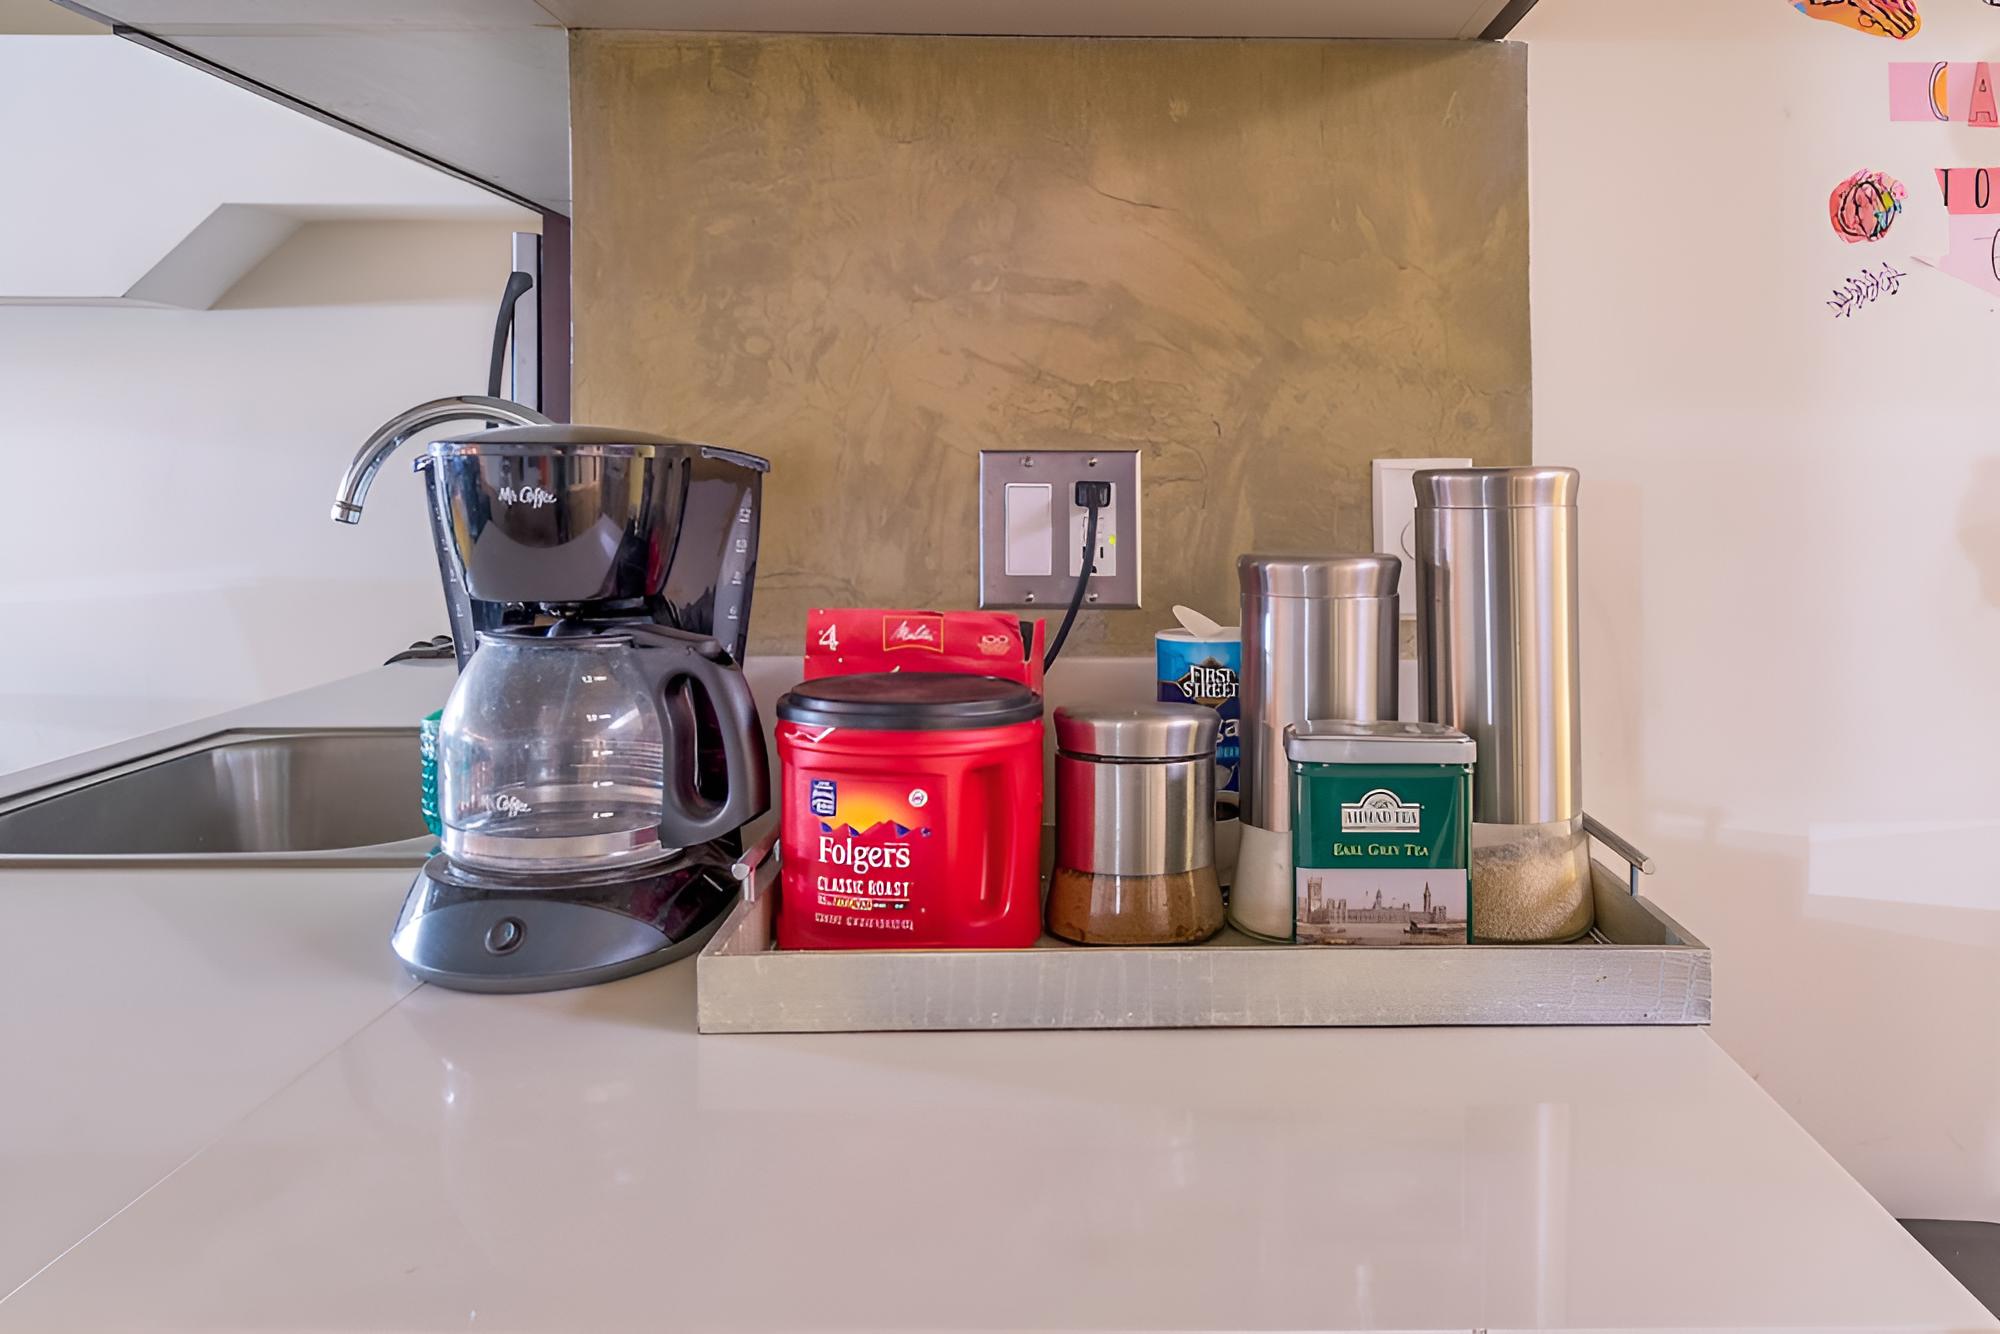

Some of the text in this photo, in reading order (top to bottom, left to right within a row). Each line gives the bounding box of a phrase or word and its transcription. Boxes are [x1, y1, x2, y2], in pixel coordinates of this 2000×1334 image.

[520, 486, 557, 508] Coffee
[819, 624, 839, 651] 4
[1190, 665, 1237, 684] FIRST
[818, 836, 910, 875] Folgers
[817, 876, 910, 898] CLASSIC ROAST
